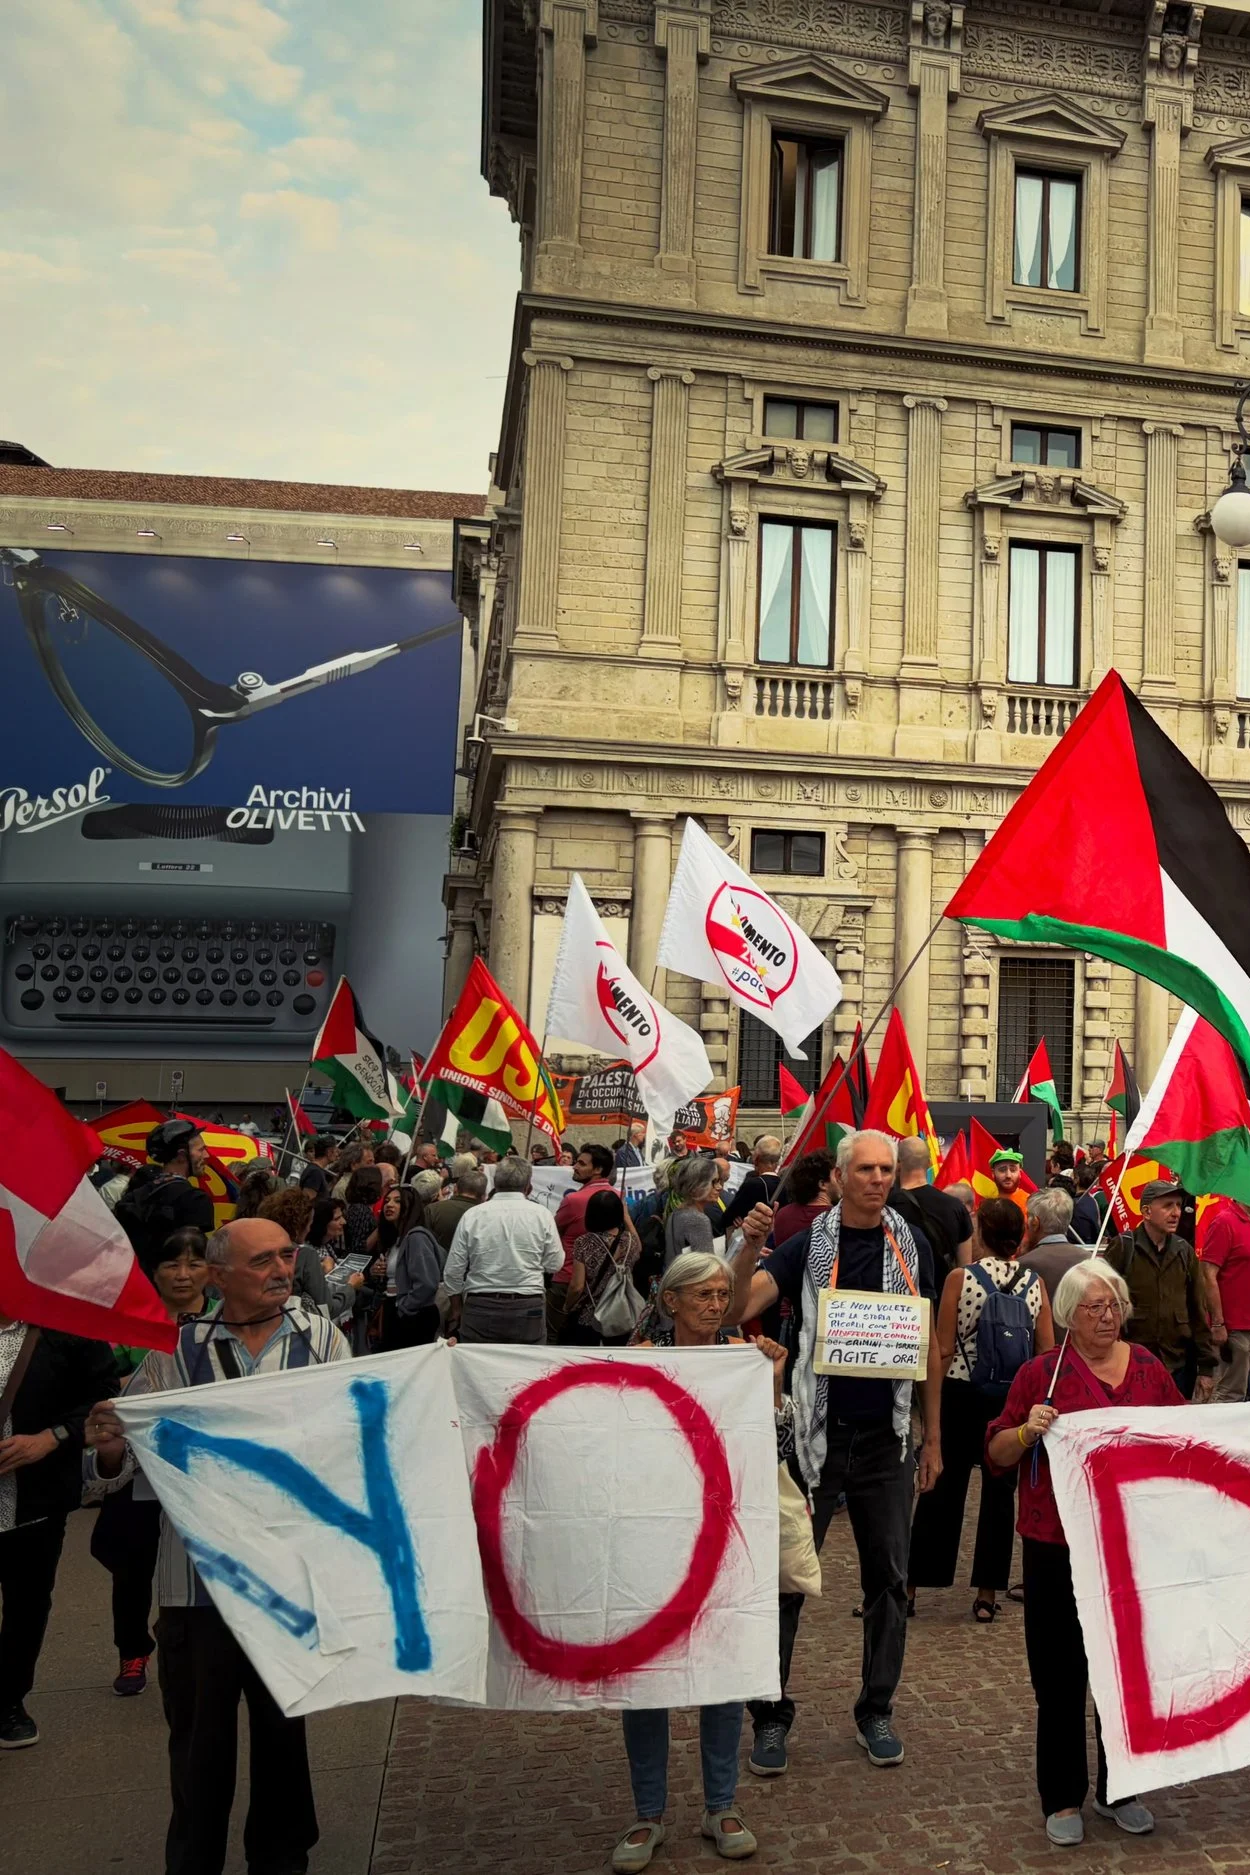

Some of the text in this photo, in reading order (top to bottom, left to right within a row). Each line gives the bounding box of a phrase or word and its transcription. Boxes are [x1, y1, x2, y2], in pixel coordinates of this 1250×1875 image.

[0, 767, 110, 832] Persol
[246, 785, 351, 810] Archivi
[226, 808, 366, 833] OLIVETTI
[449, 997, 546, 1101] US
[440, 1067, 487, 1092] UNIONE
[488, 1086, 542, 1127] SINDACALE
[1106, 1177, 1128, 1221] UNONE
[831, 1301, 913, 1312] SE NON VOLETE
[846, 1340, 882, 1348] CRIMINI
[893, 1354, 917, 1364] ORA!
